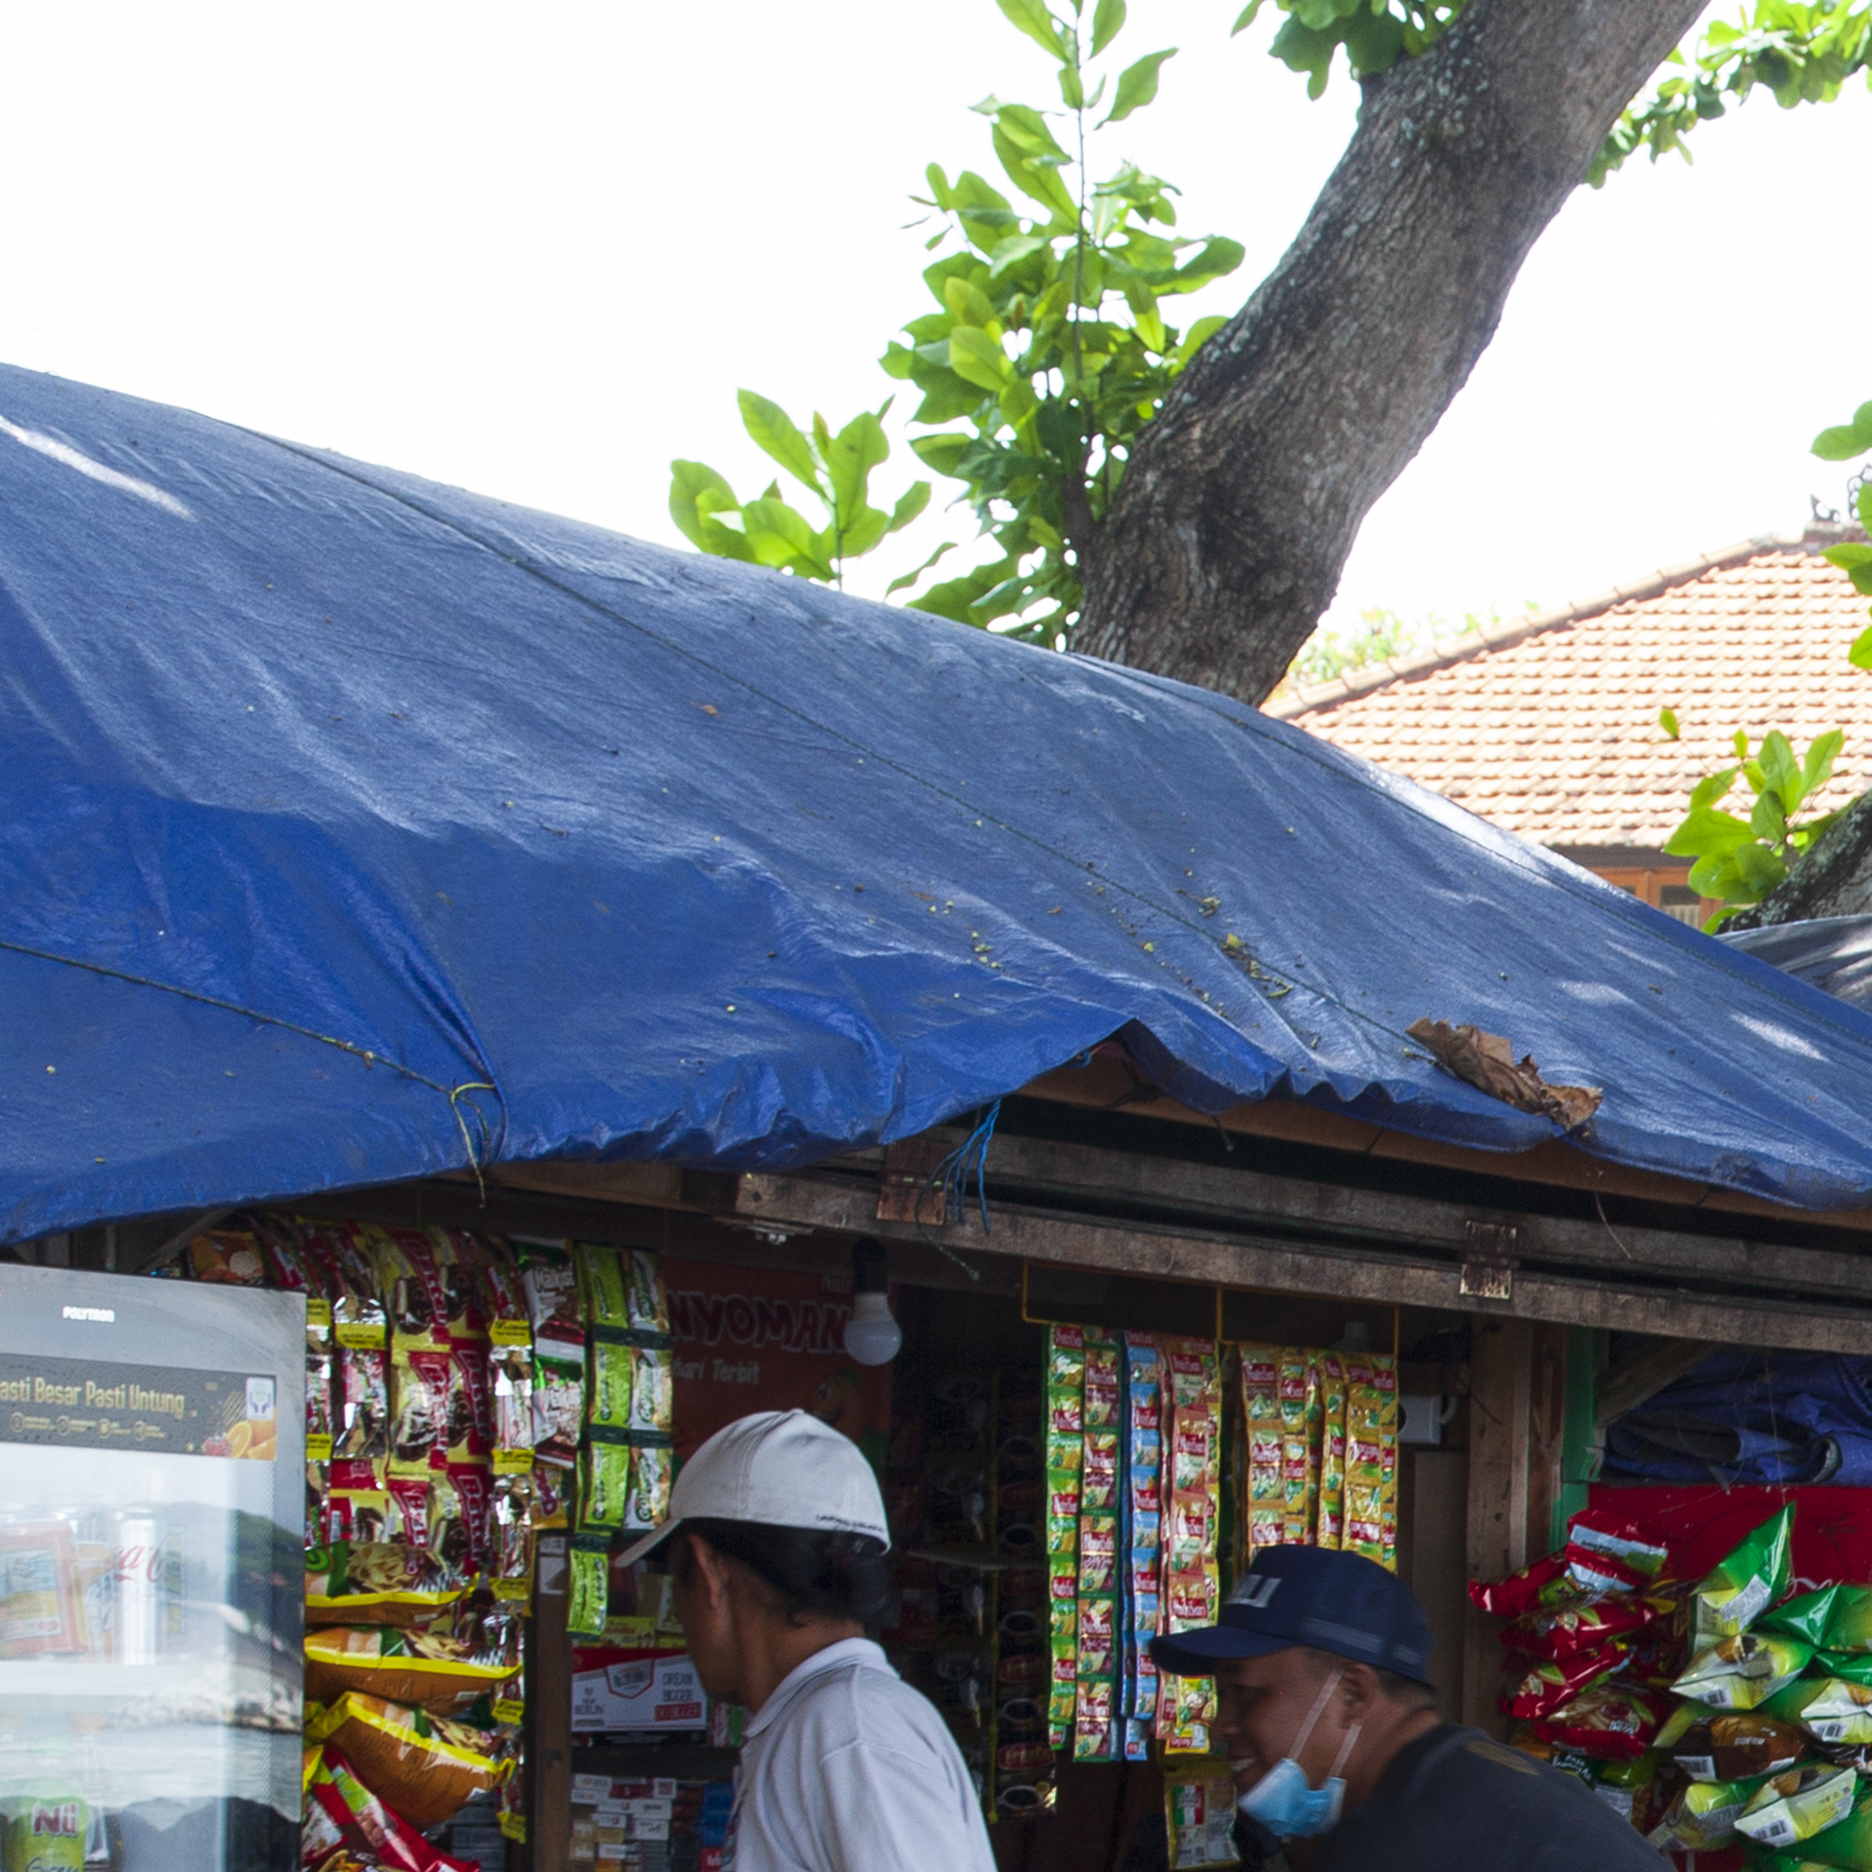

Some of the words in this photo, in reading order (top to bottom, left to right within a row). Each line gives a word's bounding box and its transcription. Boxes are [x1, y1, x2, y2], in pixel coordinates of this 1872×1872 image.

[63, 1306, 115, 1322] POLYTRON
[713, 1358, 760, 1385] Terbit
[0, 1377, 31, 1401] asti
[34, 1376, 82, 1403] Besar
[85, 1380, 126, 1408] Pasti
[129, 1385, 185, 1419] Untung
